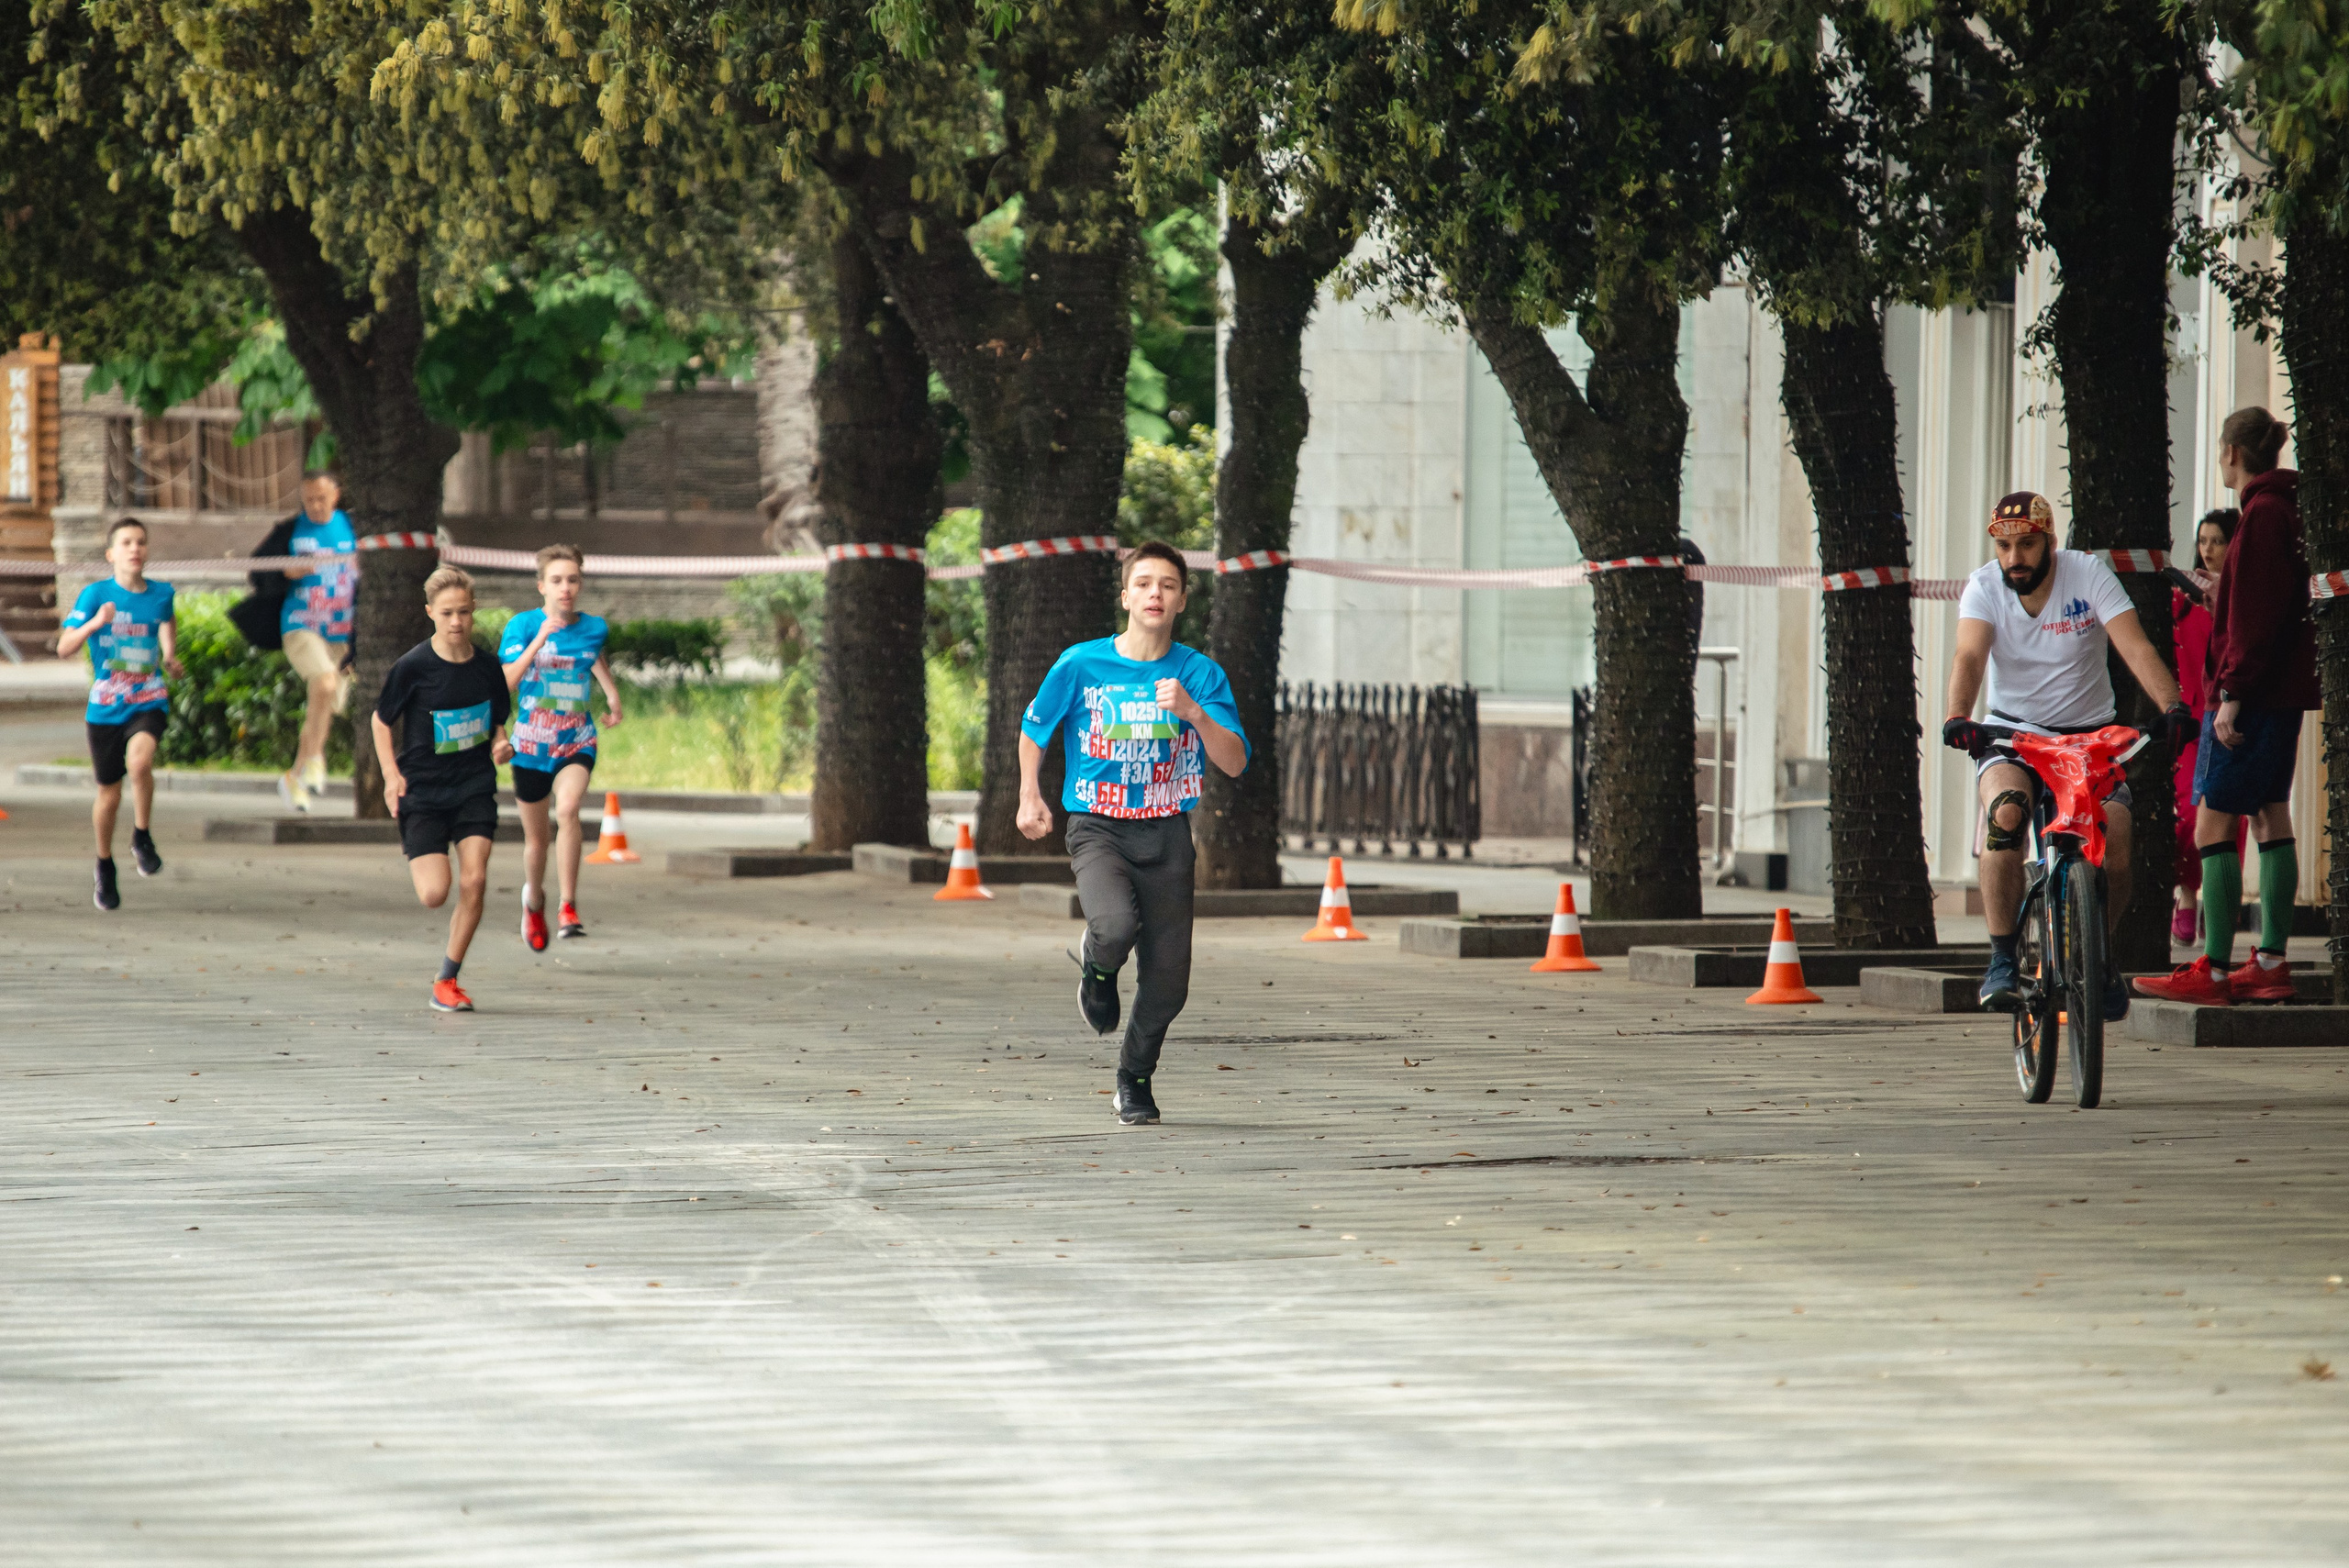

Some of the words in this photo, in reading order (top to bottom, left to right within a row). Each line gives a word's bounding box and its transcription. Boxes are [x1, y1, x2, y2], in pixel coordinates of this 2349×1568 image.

[9, 368, 29, 497] КАЛЬЯН
[2043, 619, 2071, 630] ОТЦЫ
[2055, 617, 2095, 635] РОССИИ
[1119, 701, 1163, 722] 10251
